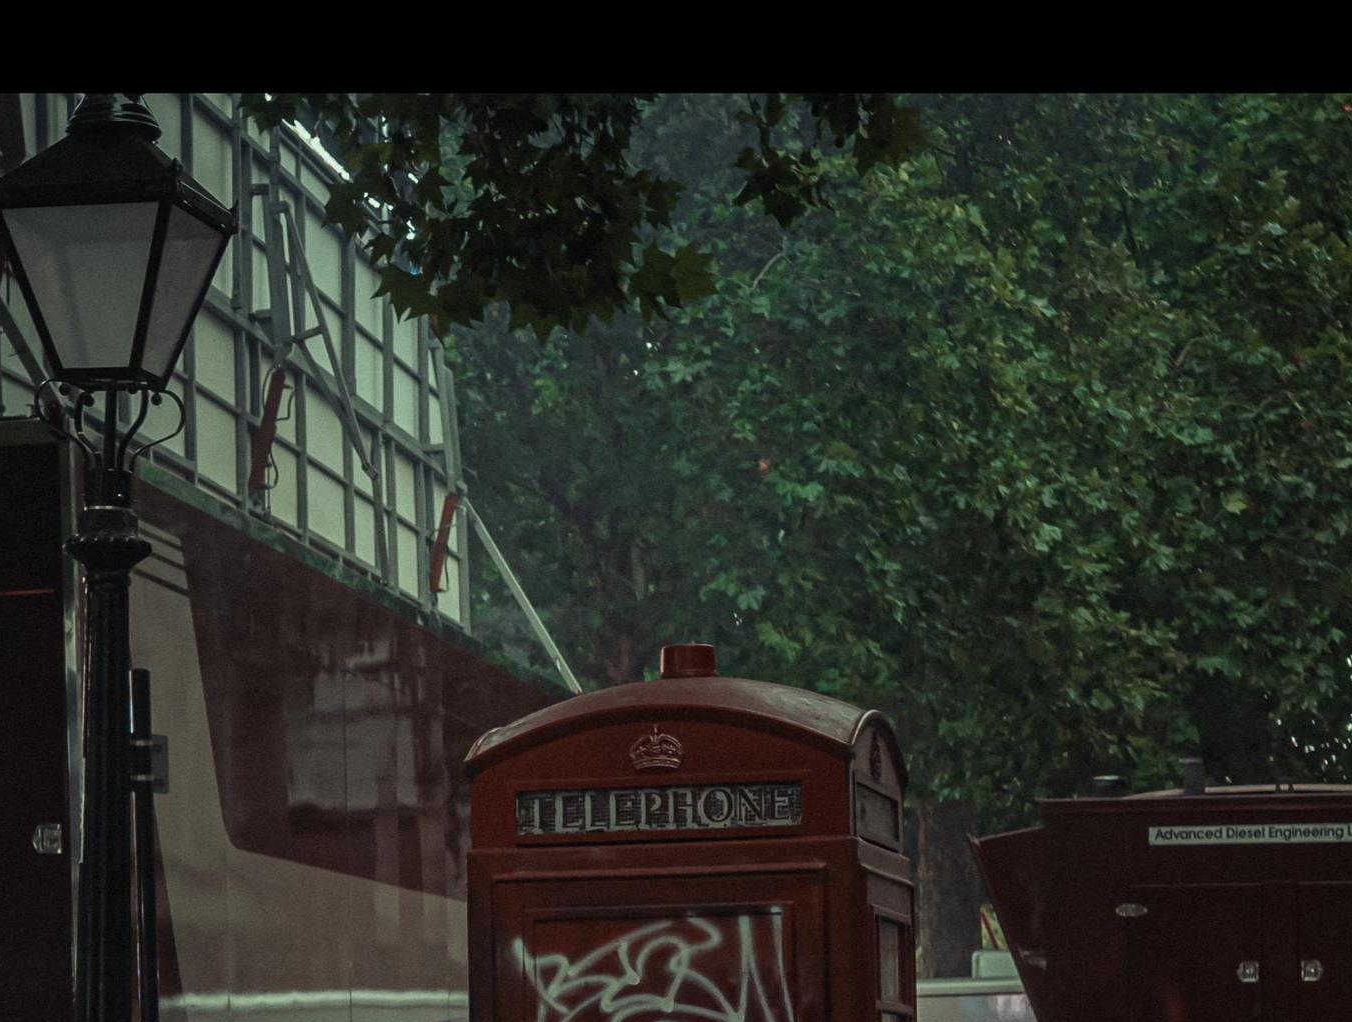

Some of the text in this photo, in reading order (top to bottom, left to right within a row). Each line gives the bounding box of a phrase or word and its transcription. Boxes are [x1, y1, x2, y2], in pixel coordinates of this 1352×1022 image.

[520, 786, 793, 833] TELEPHONE
[1154, 827, 1223, 841] Advanced
[1226, 826, 1266, 839] Diesel
[1268, 824, 1345, 840] Engineering
